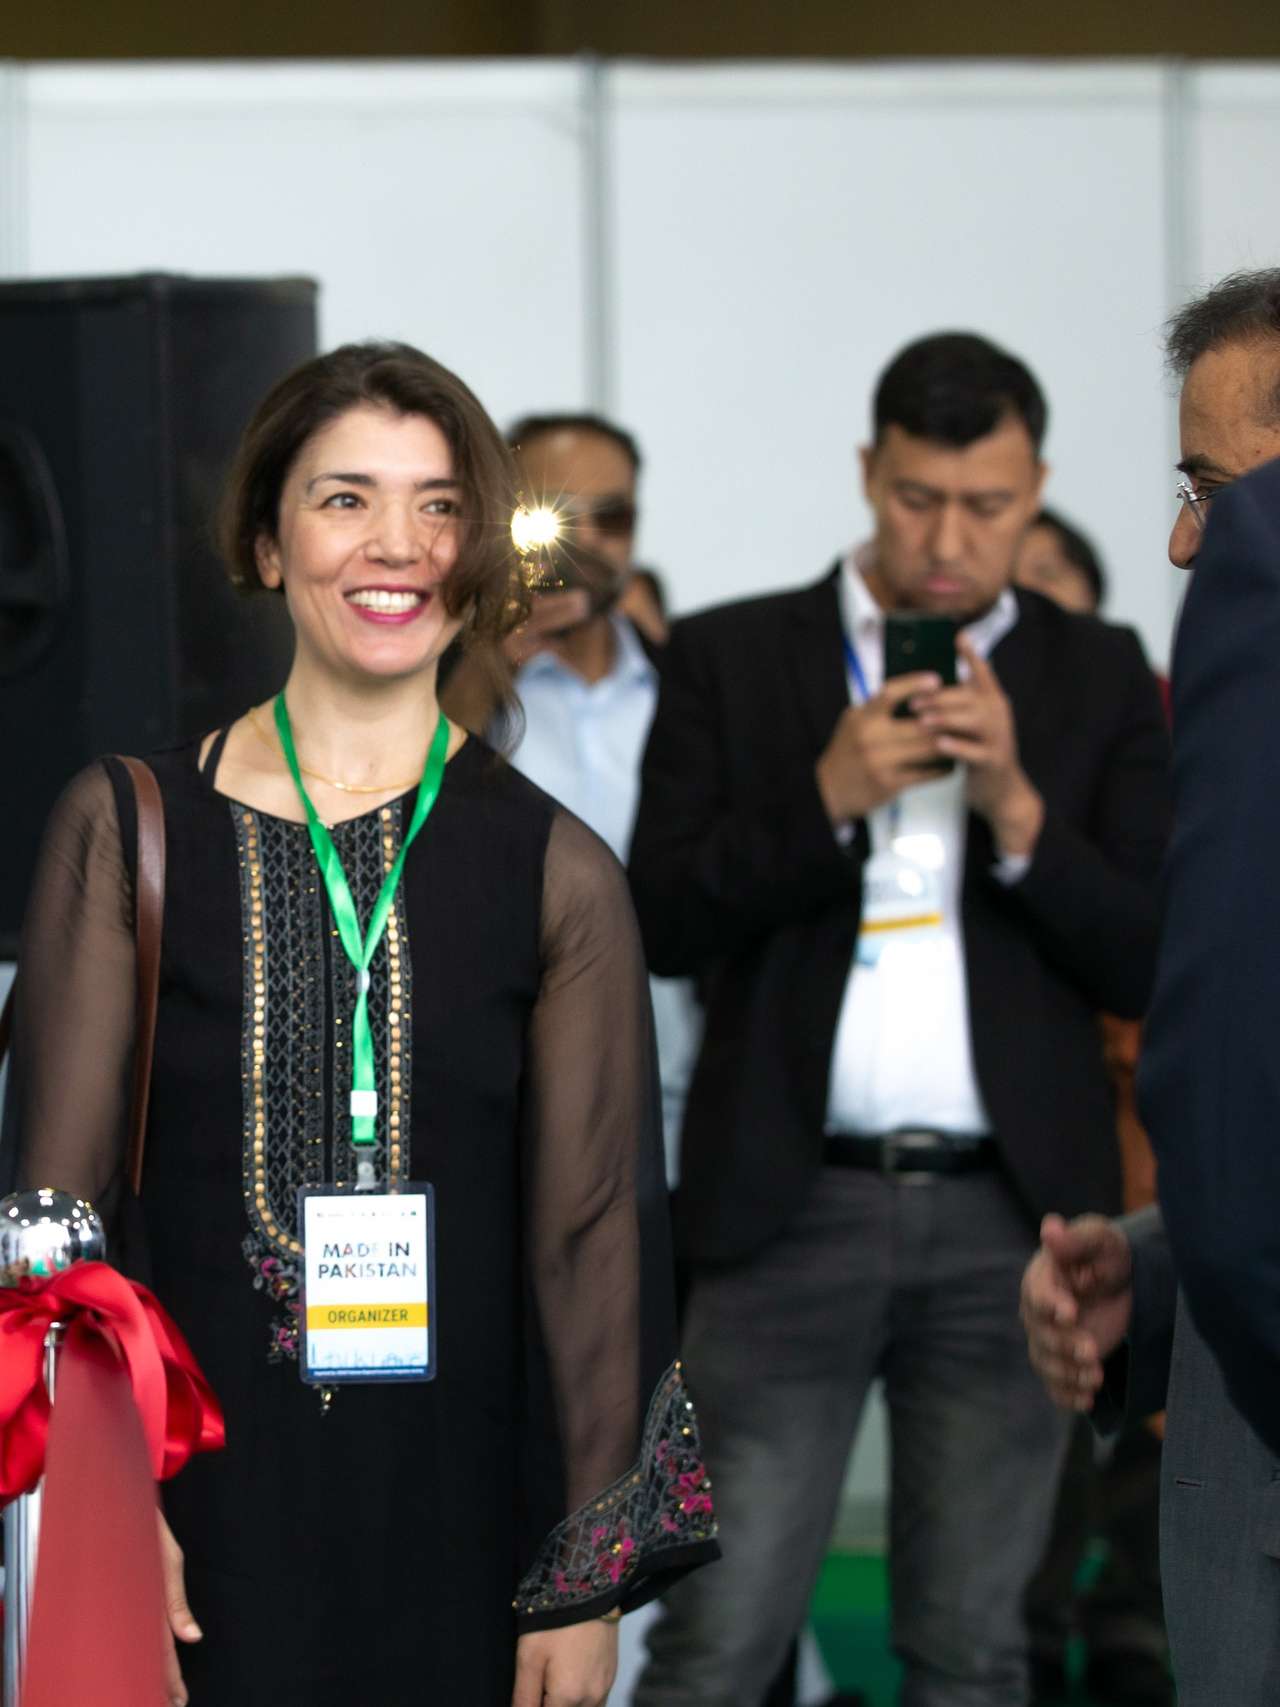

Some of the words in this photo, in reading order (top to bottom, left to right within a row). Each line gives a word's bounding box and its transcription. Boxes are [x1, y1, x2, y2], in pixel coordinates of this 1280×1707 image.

[389, 1241, 410, 1257] IN
[318, 1262, 417, 1279] PAKISTAN
[328, 1308, 409, 1324] ORGANIZER
